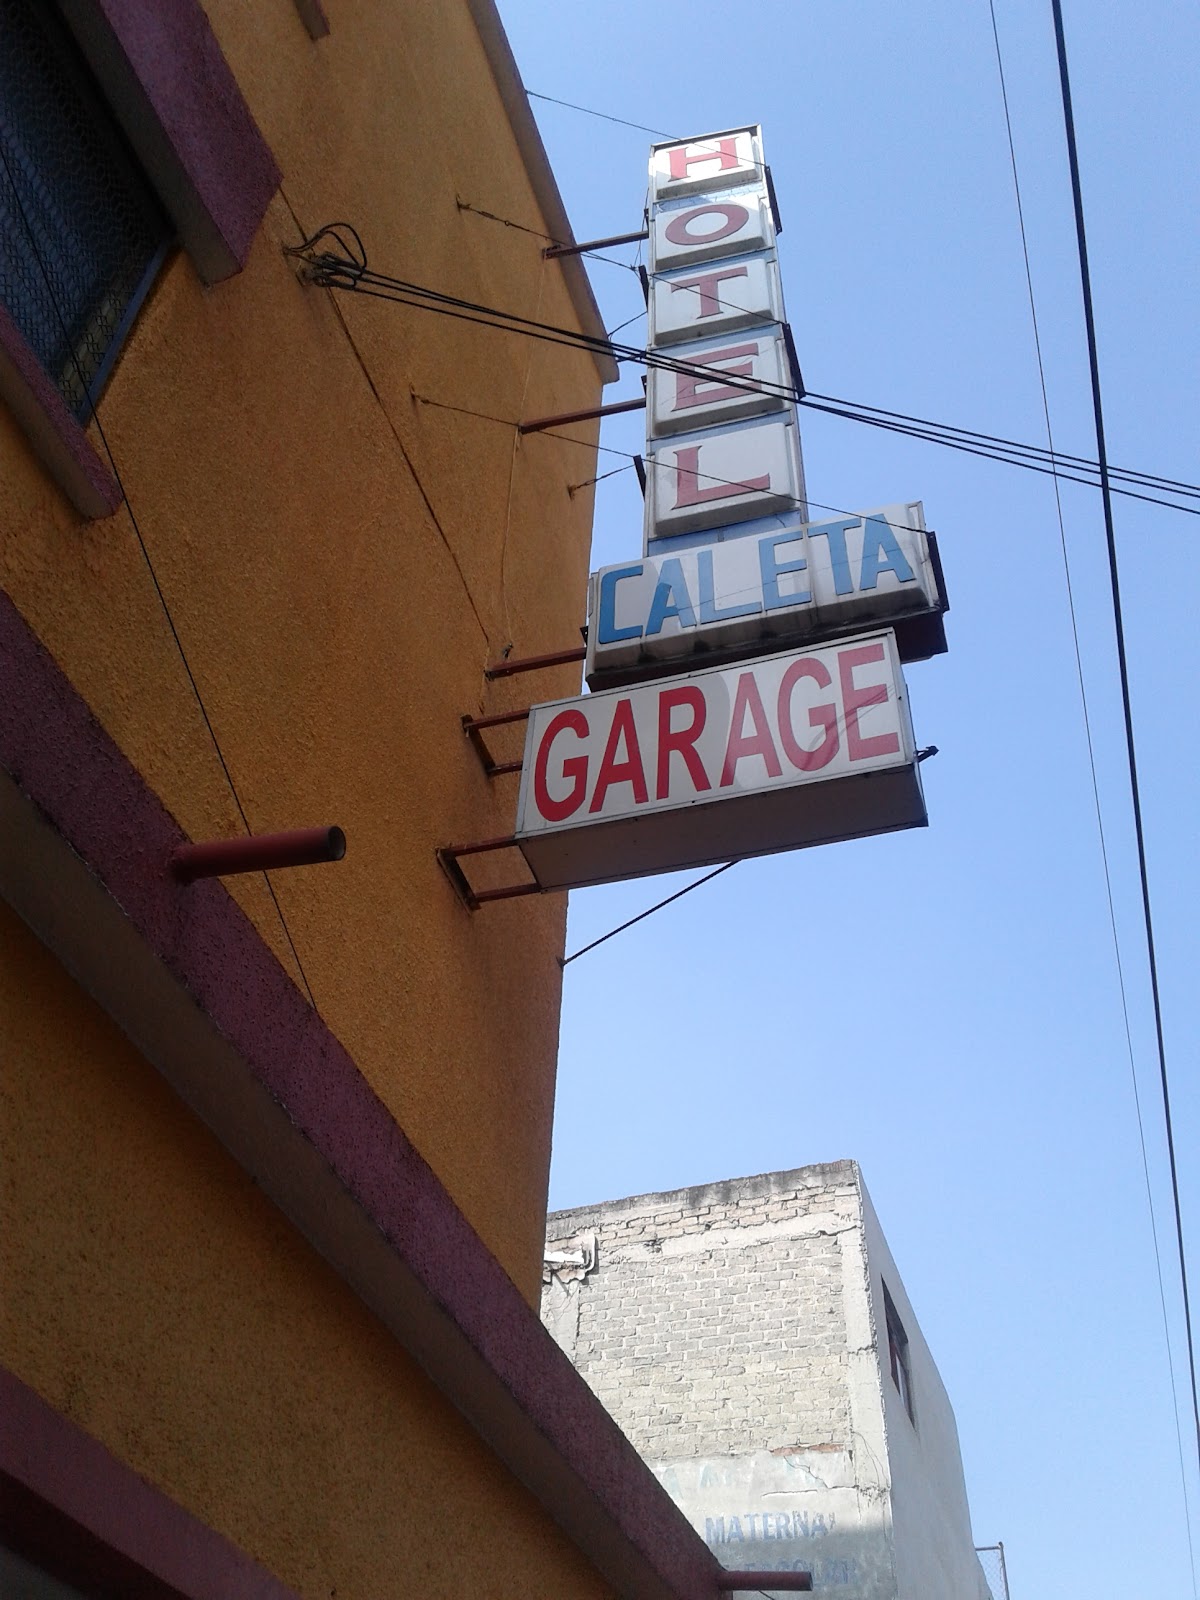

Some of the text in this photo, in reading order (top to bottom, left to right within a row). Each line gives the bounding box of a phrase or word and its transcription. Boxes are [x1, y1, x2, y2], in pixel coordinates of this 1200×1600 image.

[665, 136, 770, 510] HOTEL
[598, 513, 916, 644] CALETA
[533, 643, 901, 822] GARAGE
